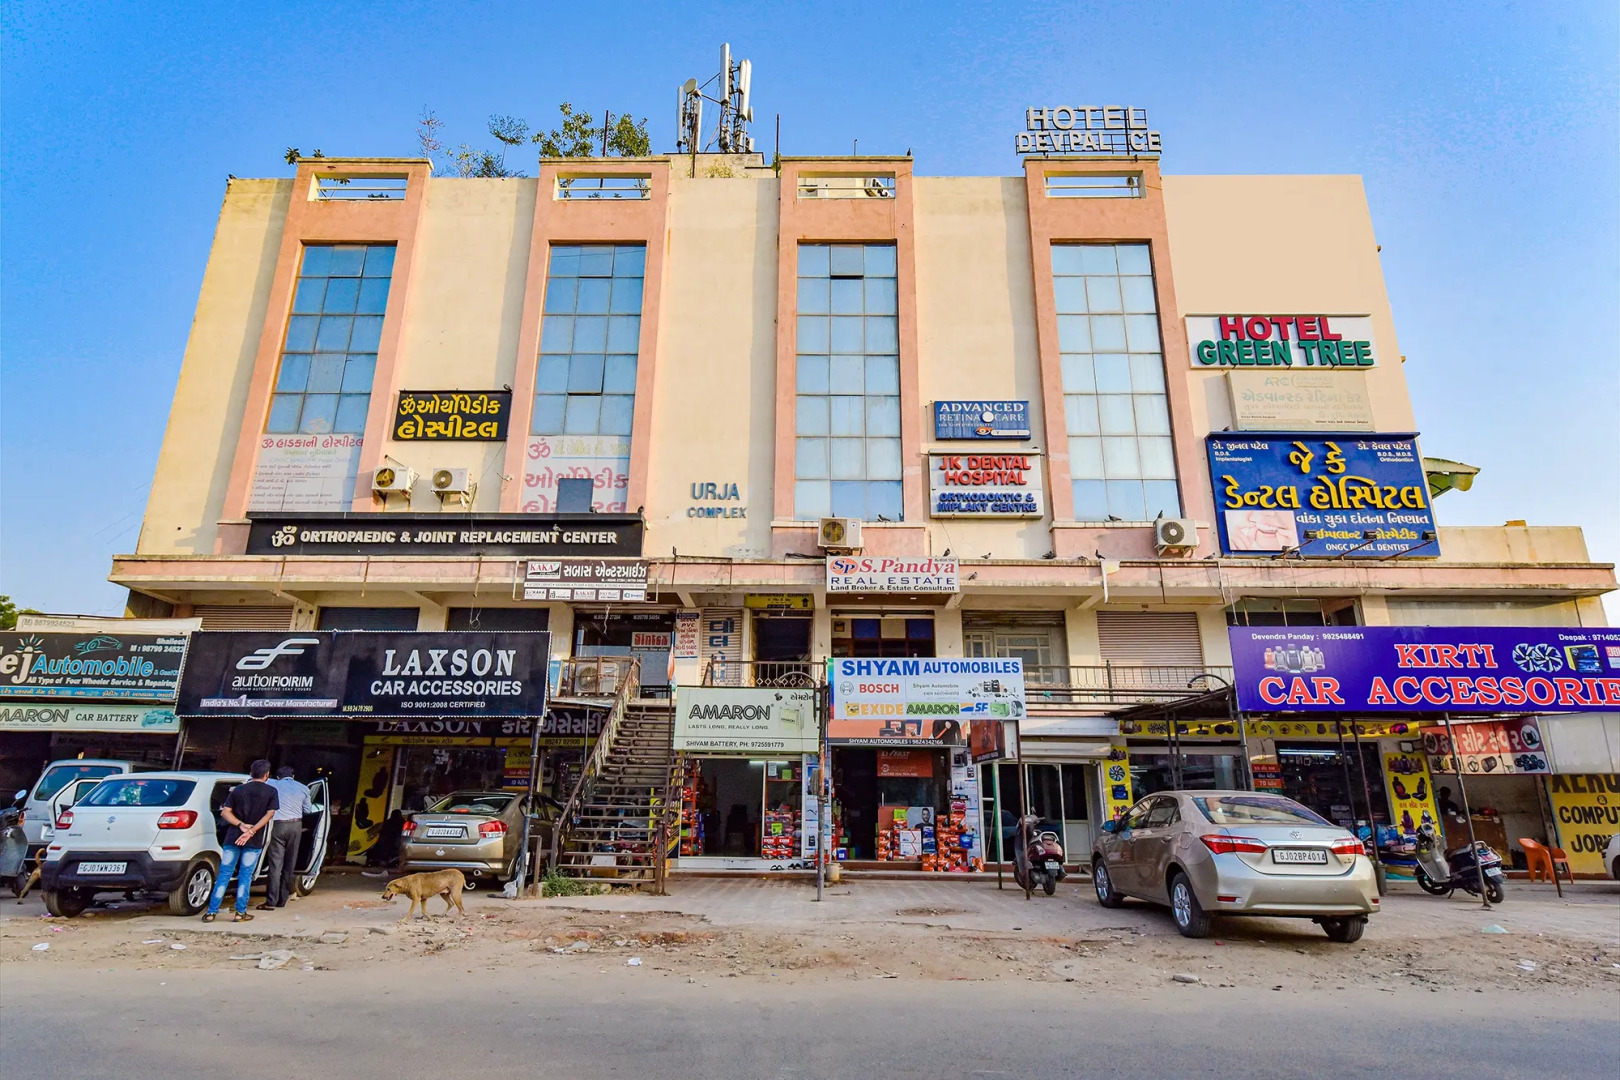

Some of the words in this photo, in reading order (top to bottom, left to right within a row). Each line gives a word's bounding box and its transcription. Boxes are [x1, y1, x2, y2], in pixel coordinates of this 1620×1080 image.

[1027, 105, 1148, 130] HOTEL
[1218, 315, 1342, 341] HOTEL
[1197, 339, 1293, 366] GREEN
[1299, 339, 1375, 366] TREE
[940, 402, 1024, 412] ADVANCED
[939, 413, 981, 422] RETINA
[994, 413, 1025, 422] CARE
[397, 414, 499, 439] હોસ્પીટલ
[275, 436, 318, 448] હાડકાની
[1250, 441, 1269, 450] પટેલ
[1392, 441, 1411, 450] પટેલ
[939, 455, 962, 470] JK
[968, 455, 1031, 471] DENTAL
[1325, 441, 1347, 474] કે
[944, 470, 1028, 486] HOSPITAL
[691, 483, 740, 500] URJA
[939, 493, 1022, 502] ORTHODONTIC
[1025, 493, 1034, 502] &
[1222, 475, 1301, 509] ડેન્ટલ
[1310, 475, 1427, 509] હોસ્પિટલ
[687, 507, 747, 519] COMPLEX
[937, 502, 989, 512] IMPLANT
[991, 502, 1037, 512] CENTRE
[1296, 513, 1321, 524] વાંકા
[300, 530, 396, 544] ORTHOPAEDIC
[400, 531, 411, 543] &
[414, 531, 457, 544] JOINT
[460, 531, 558, 544] REPLACEMENT
[562, 531, 617, 544] CENTER
[1326, 543, 1348, 551] ONGC
[1380, 543, 1410, 551] DENTIST
[530, 563, 554, 571] KAKA
[831, 577, 878, 585] REAL
[888, 577, 955, 585] ESTATE
[1287, 633, 1315, 641] Panday
[1558, 633, 1587, 642] Deepak
[1393, 643, 1499, 669] KIRTI
[0, 646, 34, 684] ej
[29, 653, 154, 678] Automobile
[382, 649, 516, 676] LAXSON
[841, 660, 920, 676] SHYAM
[923, 661, 1020, 674] AUTOMOBILES
[38, 677, 53, 685] Type
[370, 680, 405, 695] CAR
[407, 680, 522, 696] ACCESSORIES
[859, 683, 899, 694] BOSCH
[1258, 676, 1346, 705] CAR
[246, 699, 263, 707] Seat
[264, 699, 285, 707] Cover
[285, 699, 333, 707] Manufacturer
[906, 703, 960, 715] AMARON
[975, 703, 989, 712] SF
[688, 704, 771, 720] AMARON
[860, 703, 904, 716] EXIDE
[75, 713, 95, 722] CAR
[97, 713, 139, 722] BATTERY
[376, 719, 482, 734] LAXSON
[1559, 805, 1620, 824] COMPU
